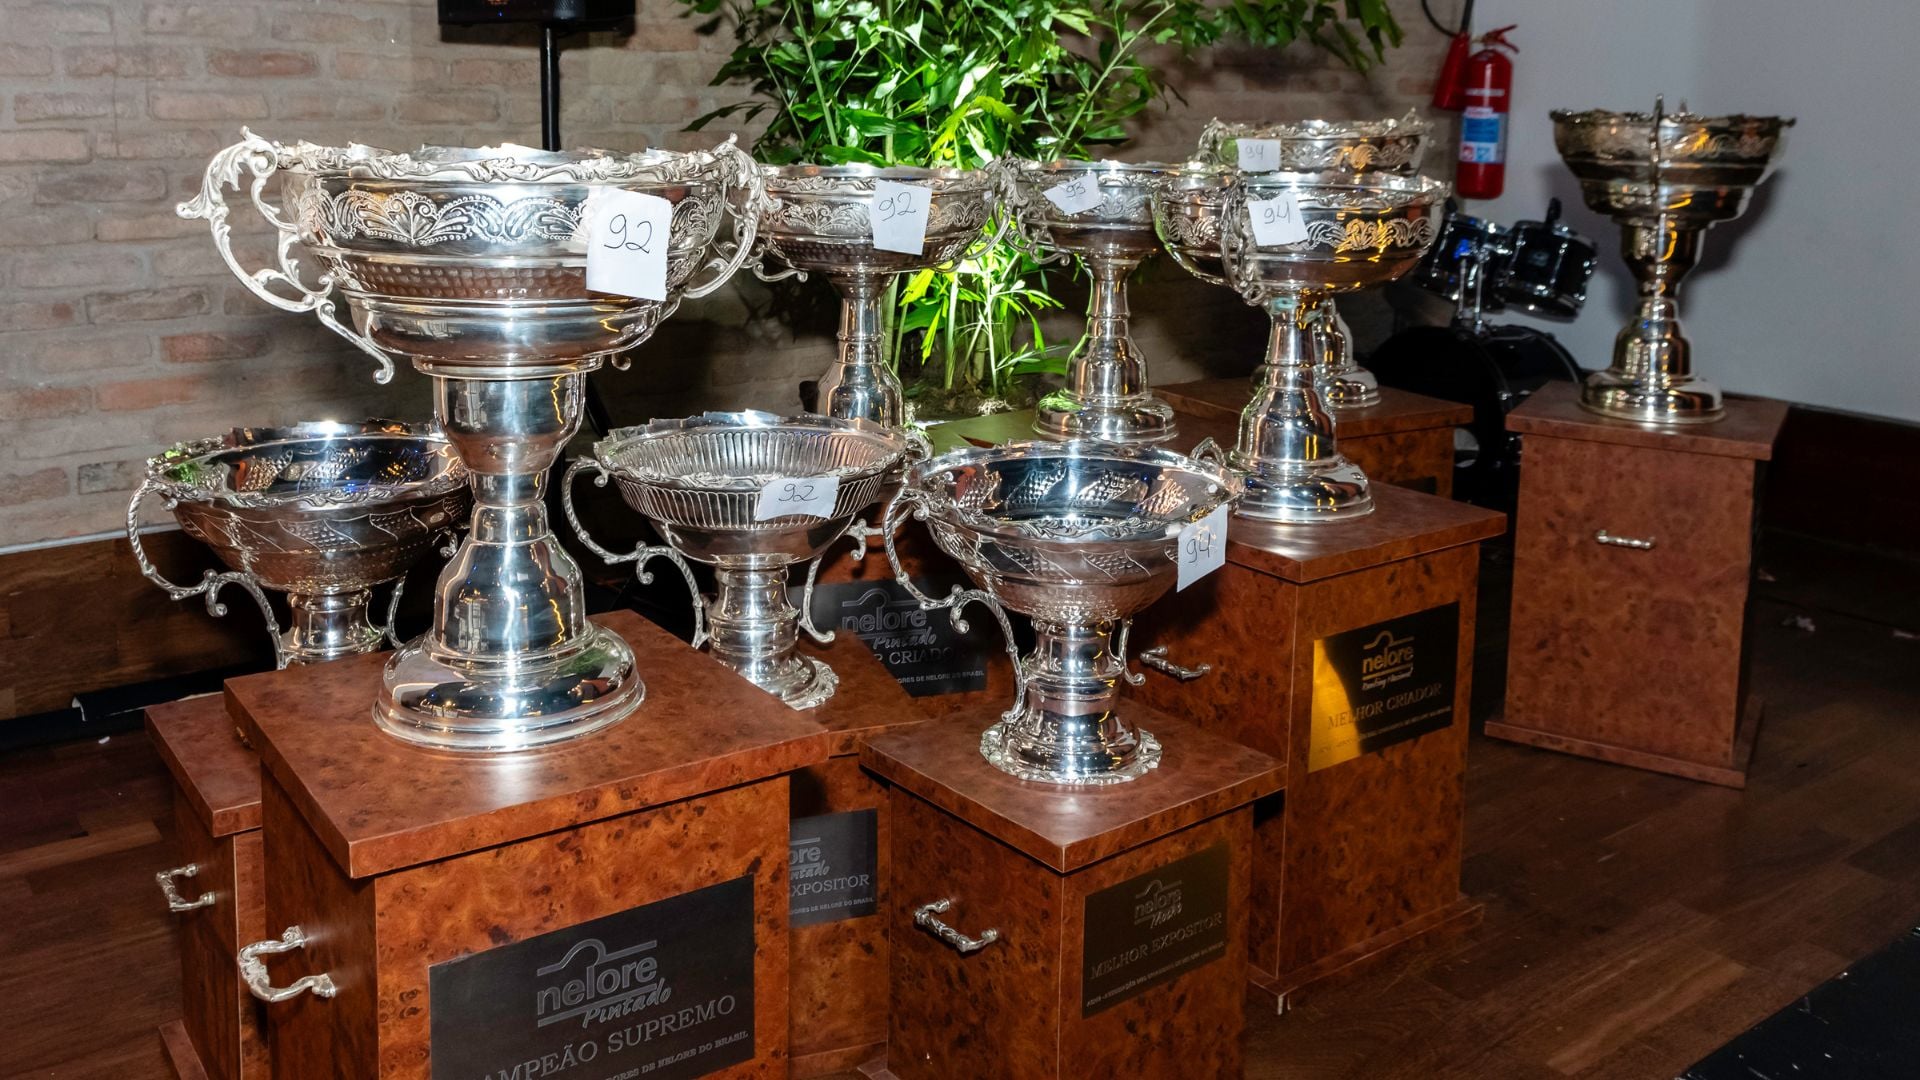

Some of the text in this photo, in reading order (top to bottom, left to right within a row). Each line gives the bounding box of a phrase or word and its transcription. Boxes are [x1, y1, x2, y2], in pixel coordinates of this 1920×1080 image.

[878, 191, 918, 222] 92
[1263, 200, 1291, 225] 94
[603, 213, 653, 255] 92
[778, 483, 818, 502] 92
[1186, 531, 1211, 564] 94
[841, 607, 927, 633] nelore
[1362, 646, 1415, 674] nelore
[1327, 700, 1384, 730] MELHOR
[1386, 682, 1442, 711] CRIADOR
[1134, 888, 1182, 919] nelore
[1089, 943, 1149, 980] MELHOR
[1152, 911, 1223, 954] EXPOSITOR
[536, 956, 658, 1016] nelore
[484, 994, 736, 1080] MPEÃO SUPREMO
[641, 1061, 657, 1074] DE
[698, 1042, 713, 1055] DO
[714, 1030, 749, 1049] BRASIL
